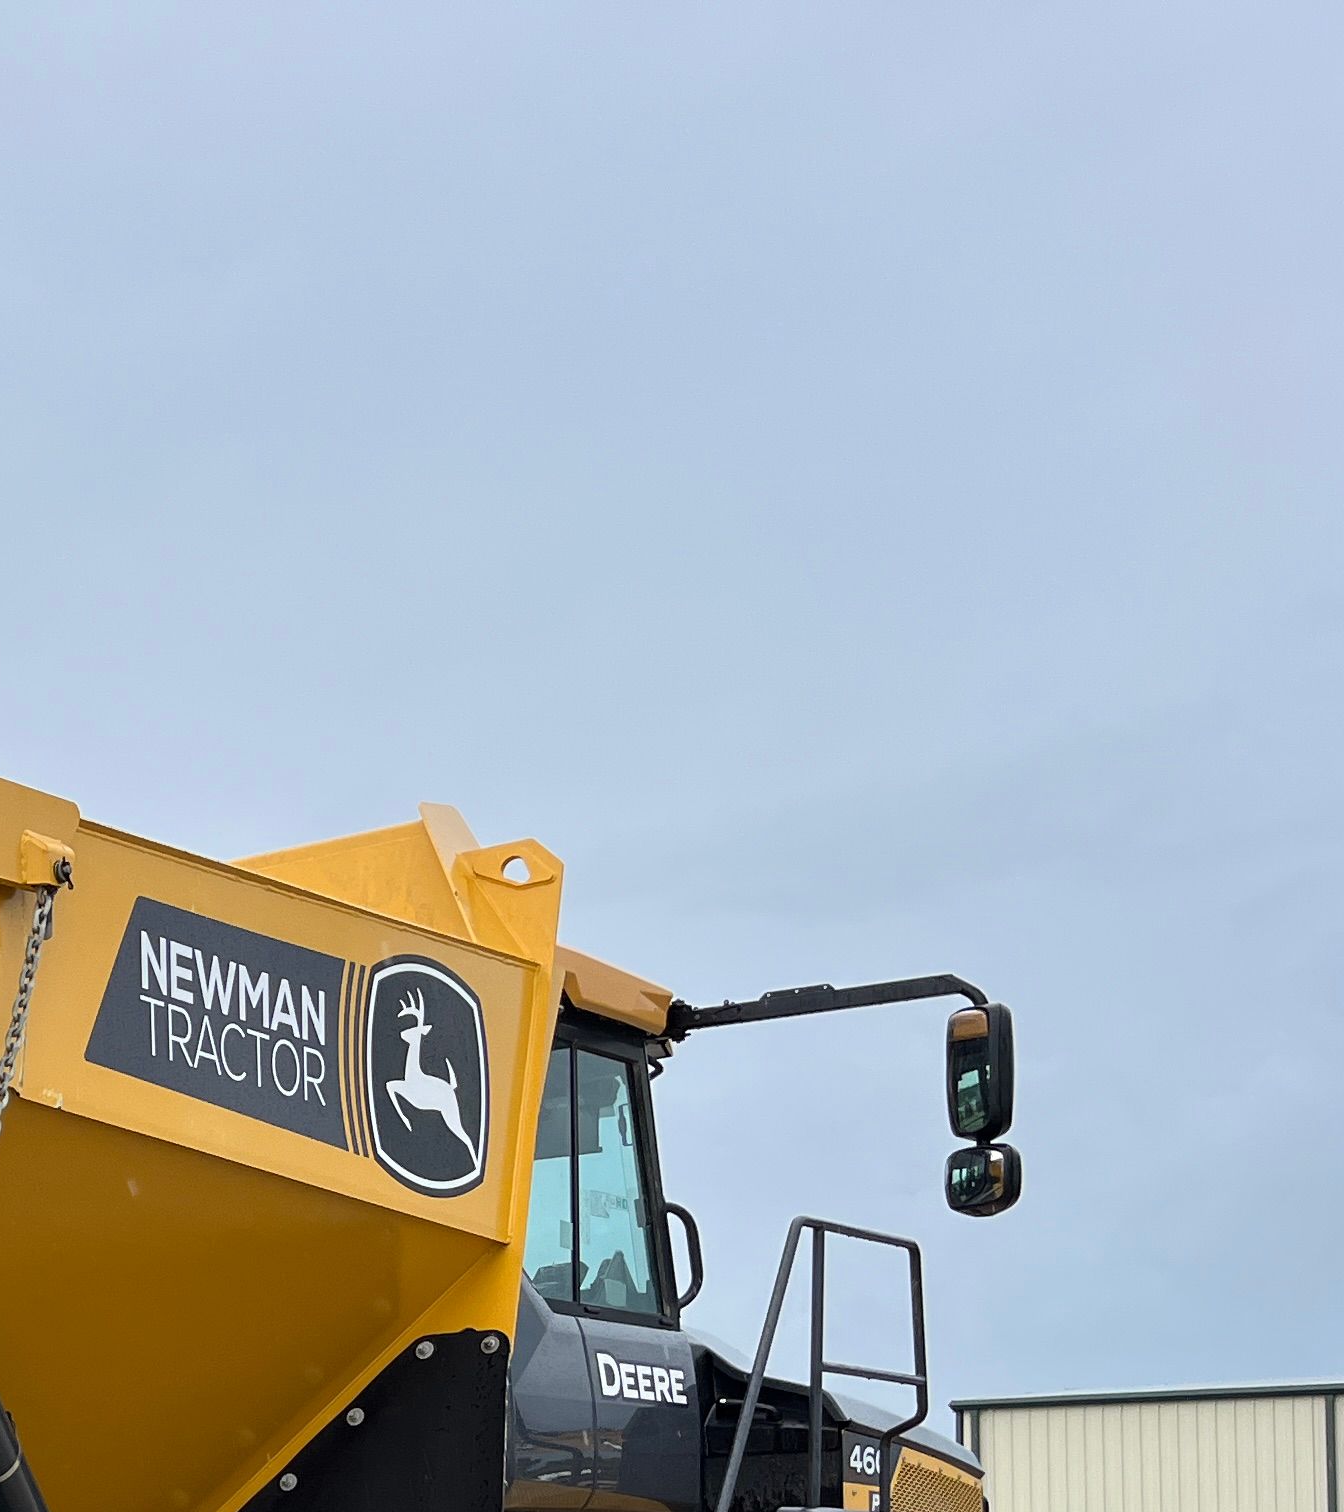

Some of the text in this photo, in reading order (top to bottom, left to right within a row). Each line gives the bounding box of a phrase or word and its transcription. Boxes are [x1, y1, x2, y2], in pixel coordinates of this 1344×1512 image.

[139, 930, 326, 1046] NEWMAN
[139, 994, 327, 1107] TRACTOR
[596, 1352, 688, 1405] DEERE
